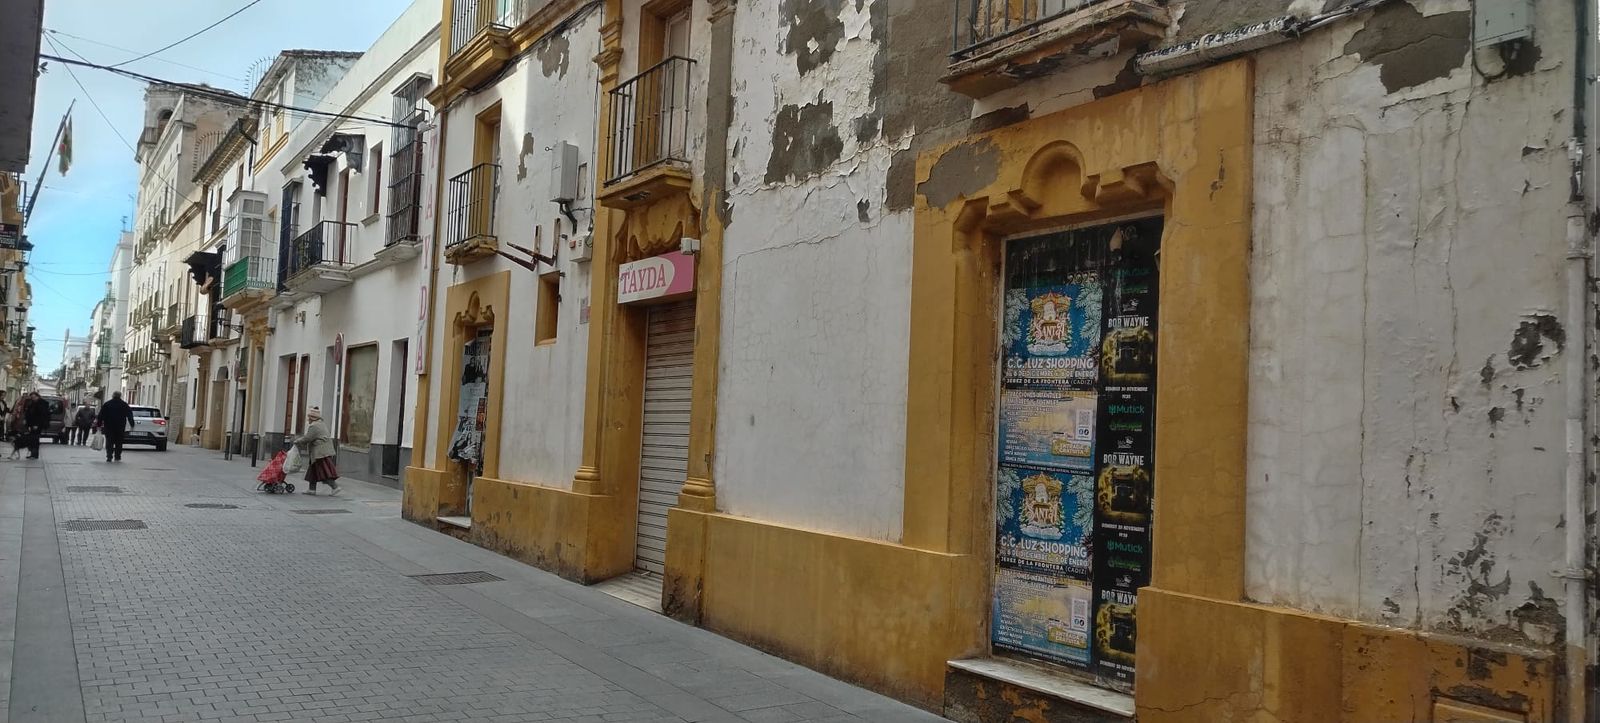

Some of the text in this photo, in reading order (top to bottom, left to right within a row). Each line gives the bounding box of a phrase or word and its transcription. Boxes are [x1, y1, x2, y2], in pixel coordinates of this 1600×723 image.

[416, 135, 437, 371] TAYDA
[620, 264, 666, 294] TAYDA
[1108, 316, 1149, 328] BOB WAYNE
[1027, 358, 1044, 369] LUZ
[1046, 358, 1094, 369] SHOPPING
[1116, 404, 1145, 414] Mutick
[1103, 453, 1145, 466] BOB WAYNE
[1021, 538, 1038, 550] LUZ
[1039, 541, 1087, 558] SHOPPING
[1114, 541, 1144, 554] Mutick
[1101, 589, 1116, 601] BOB
